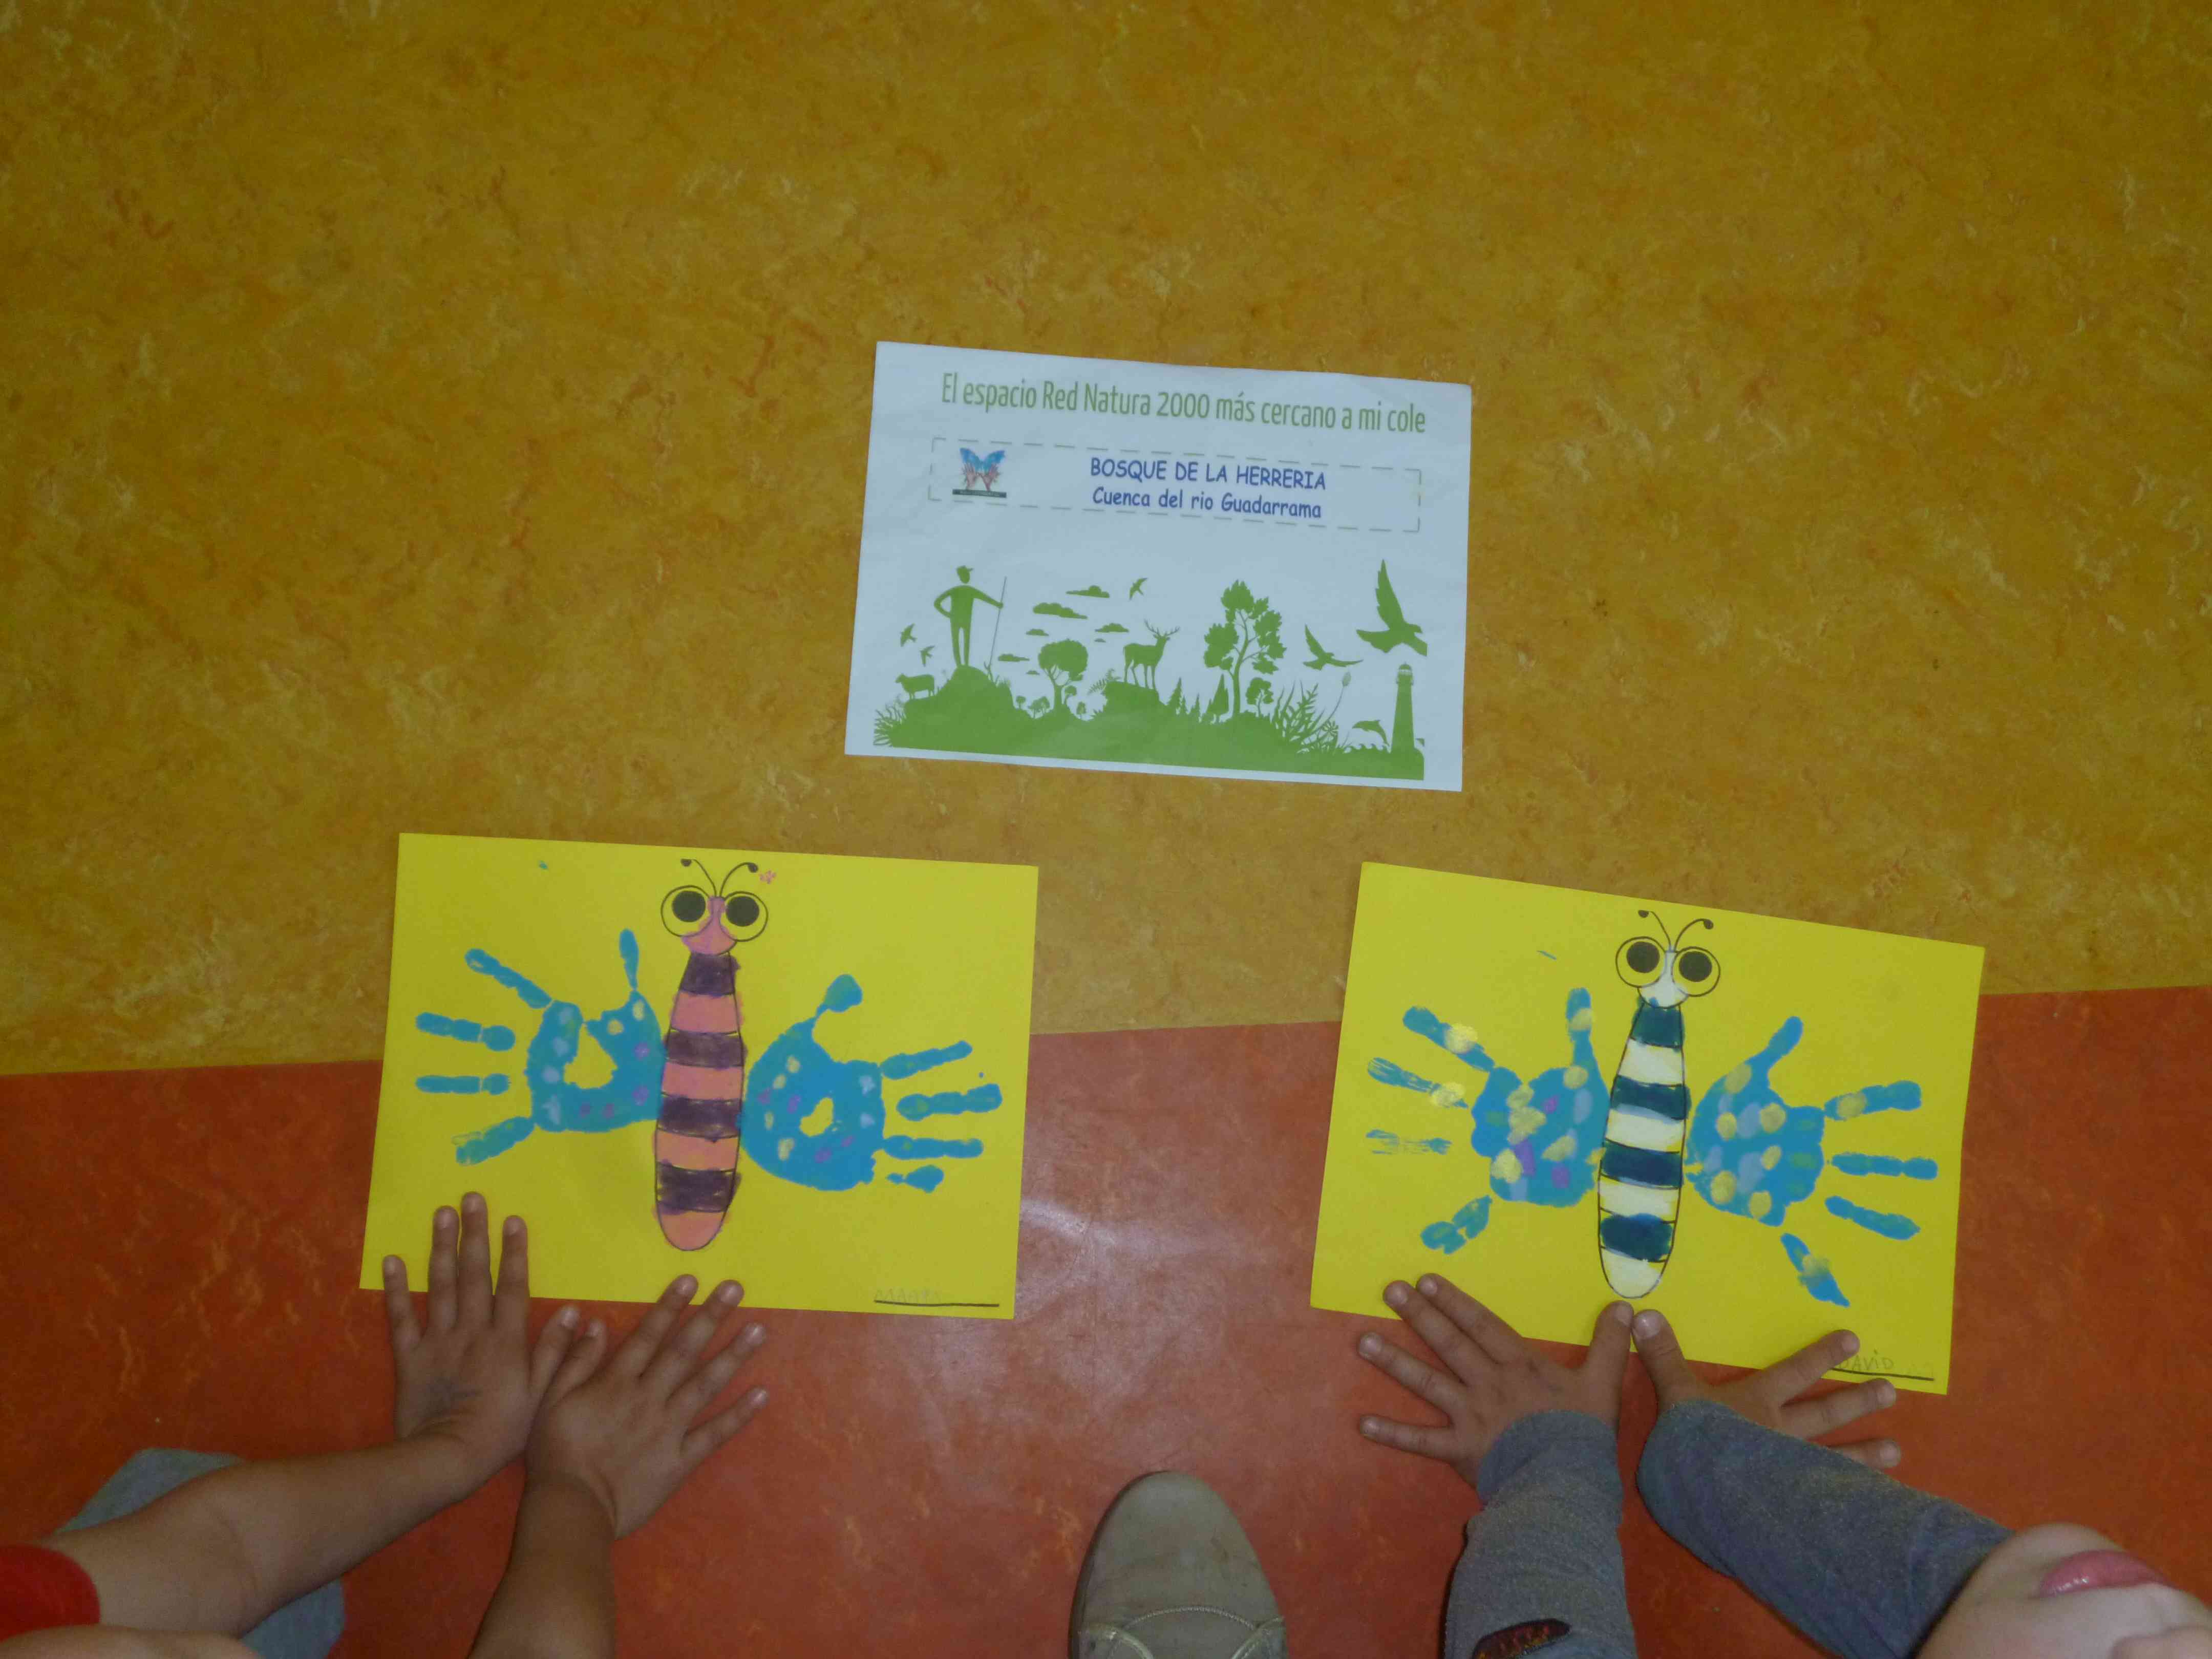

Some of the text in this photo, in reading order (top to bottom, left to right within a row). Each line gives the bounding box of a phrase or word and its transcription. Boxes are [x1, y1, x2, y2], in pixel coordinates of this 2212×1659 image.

[941, 372, 1426, 433] El espacio Red Natura 2000 más cercano a mi cole
[1091, 457, 1326, 490] BOSQUE DE LA HERRERIA
[1093, 486, 1321, 518] Cuenca del rio Guadarrama
